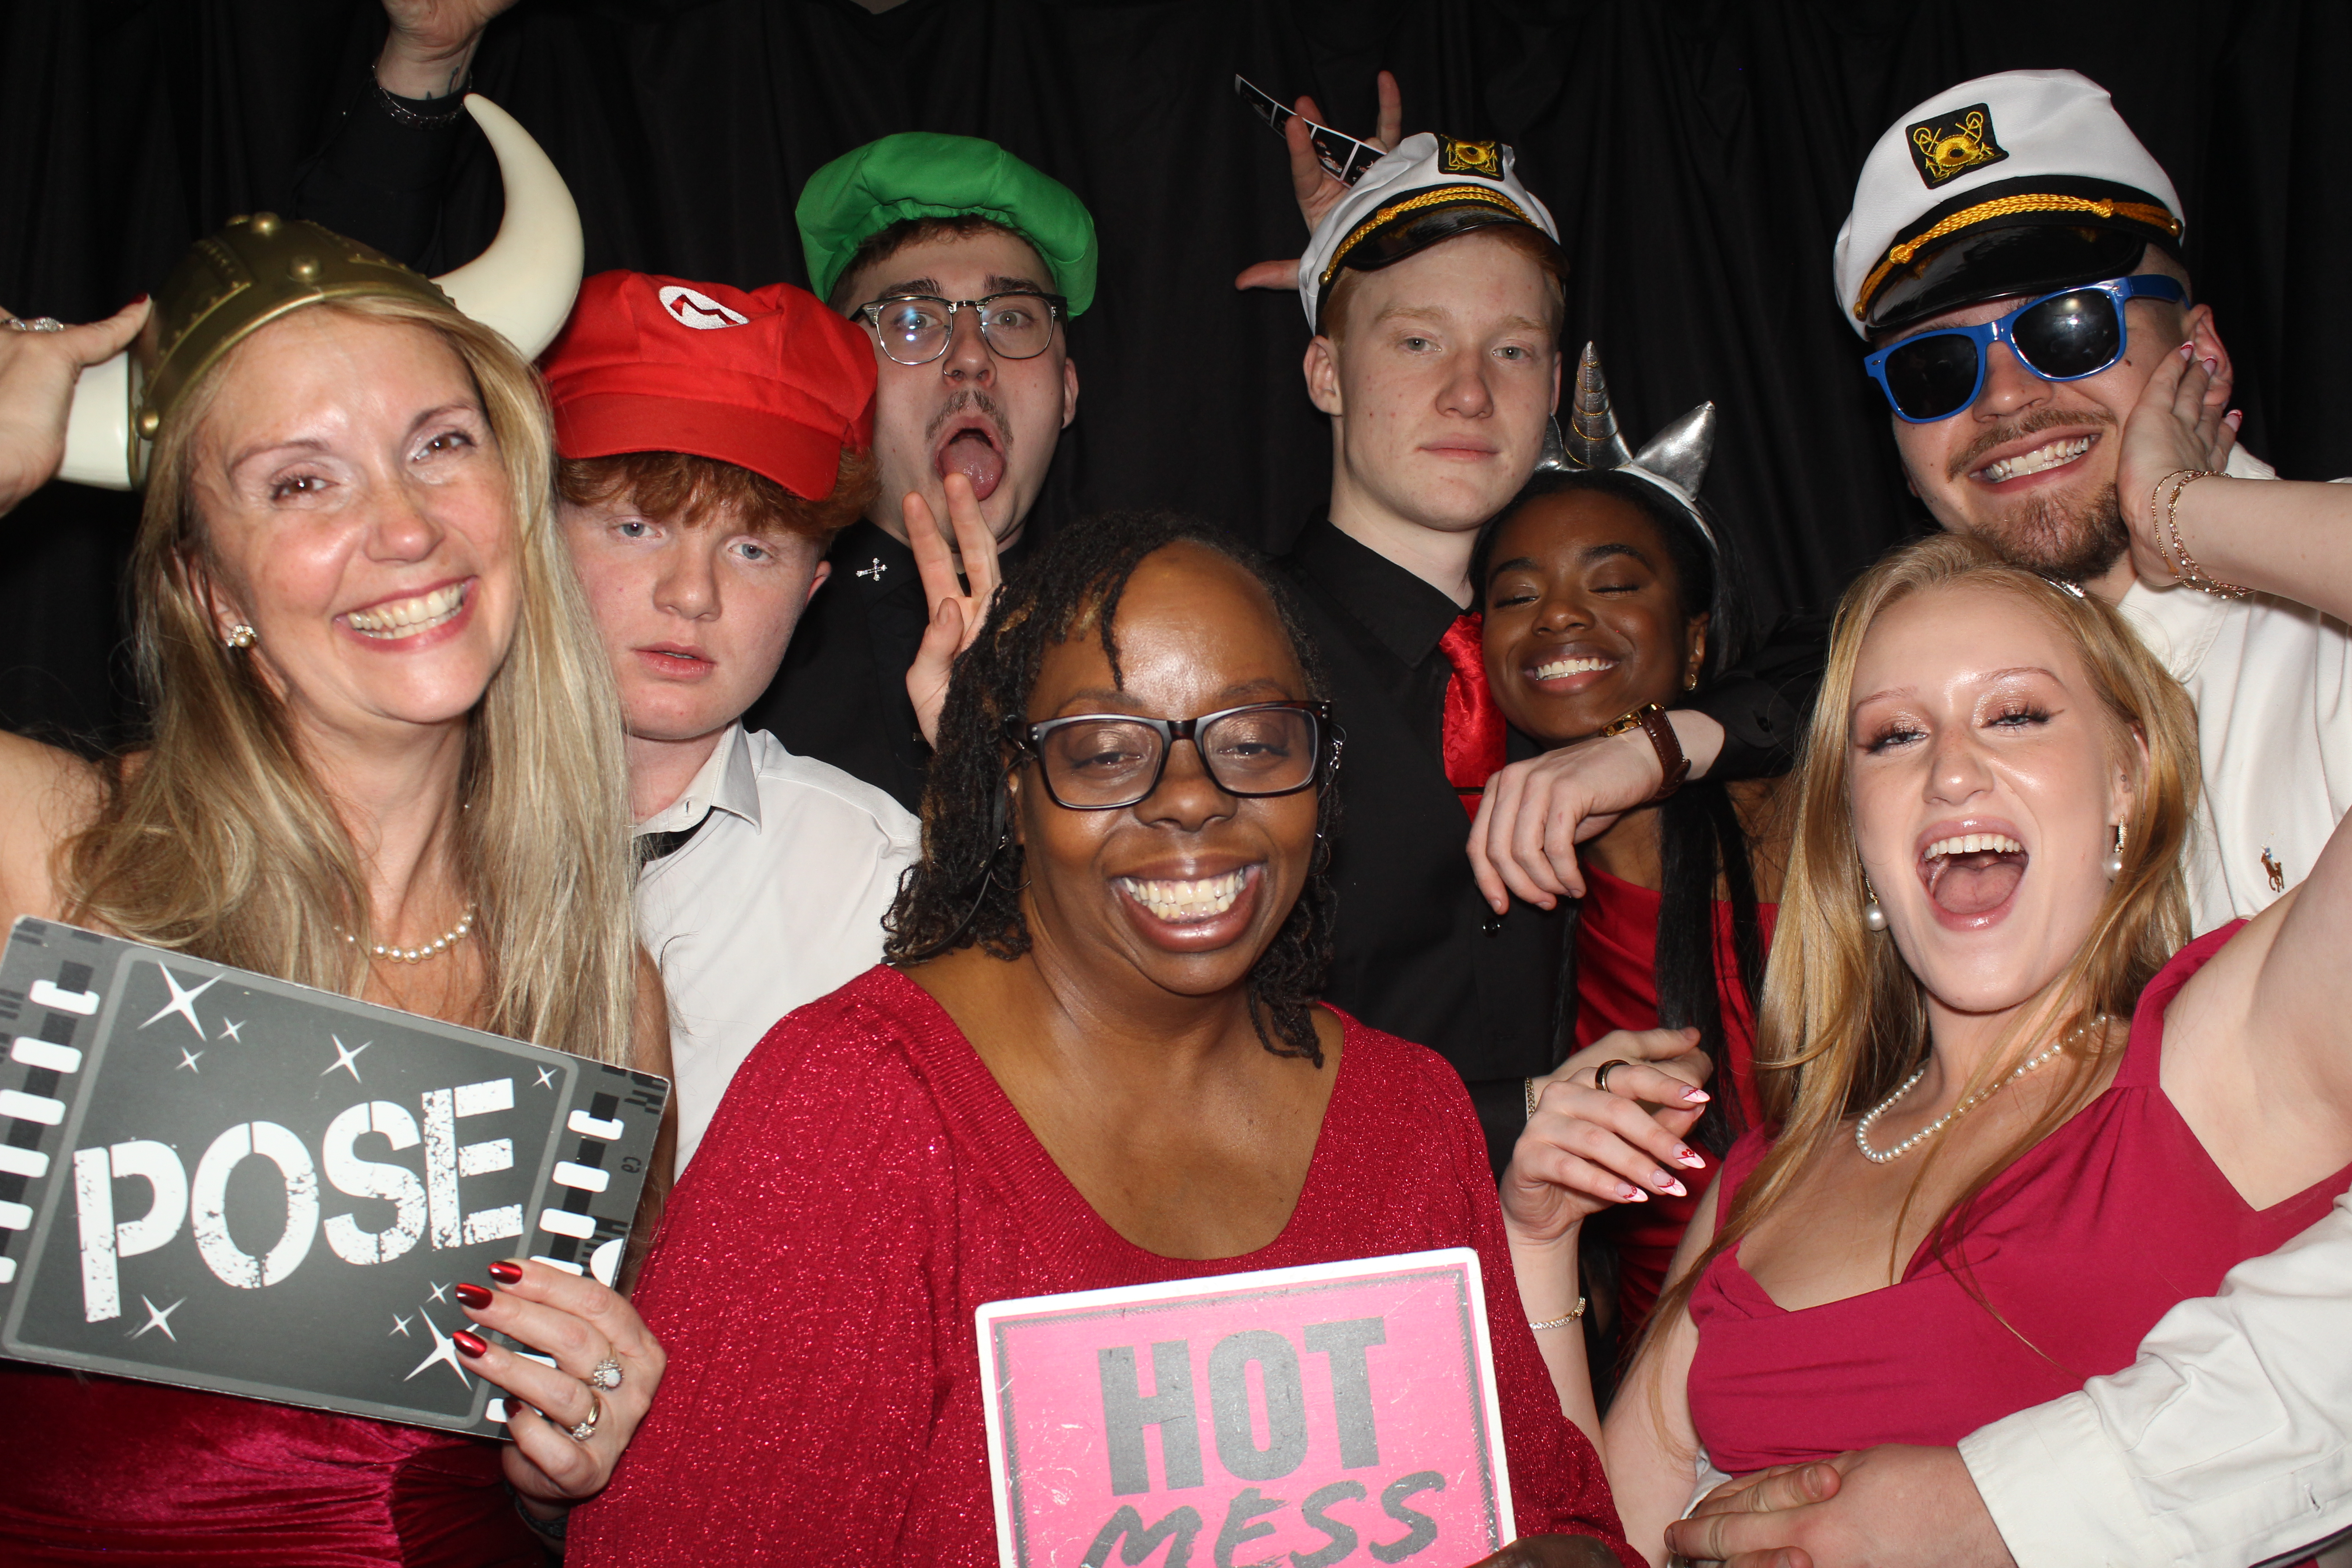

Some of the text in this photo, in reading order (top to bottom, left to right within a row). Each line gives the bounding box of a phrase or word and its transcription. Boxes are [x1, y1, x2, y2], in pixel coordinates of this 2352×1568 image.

[74, 1077, 524, 1323] POSE
[1098, 1316, 1387, 1496] HOT
[1078, 1470, 1446, 1568] MESS
